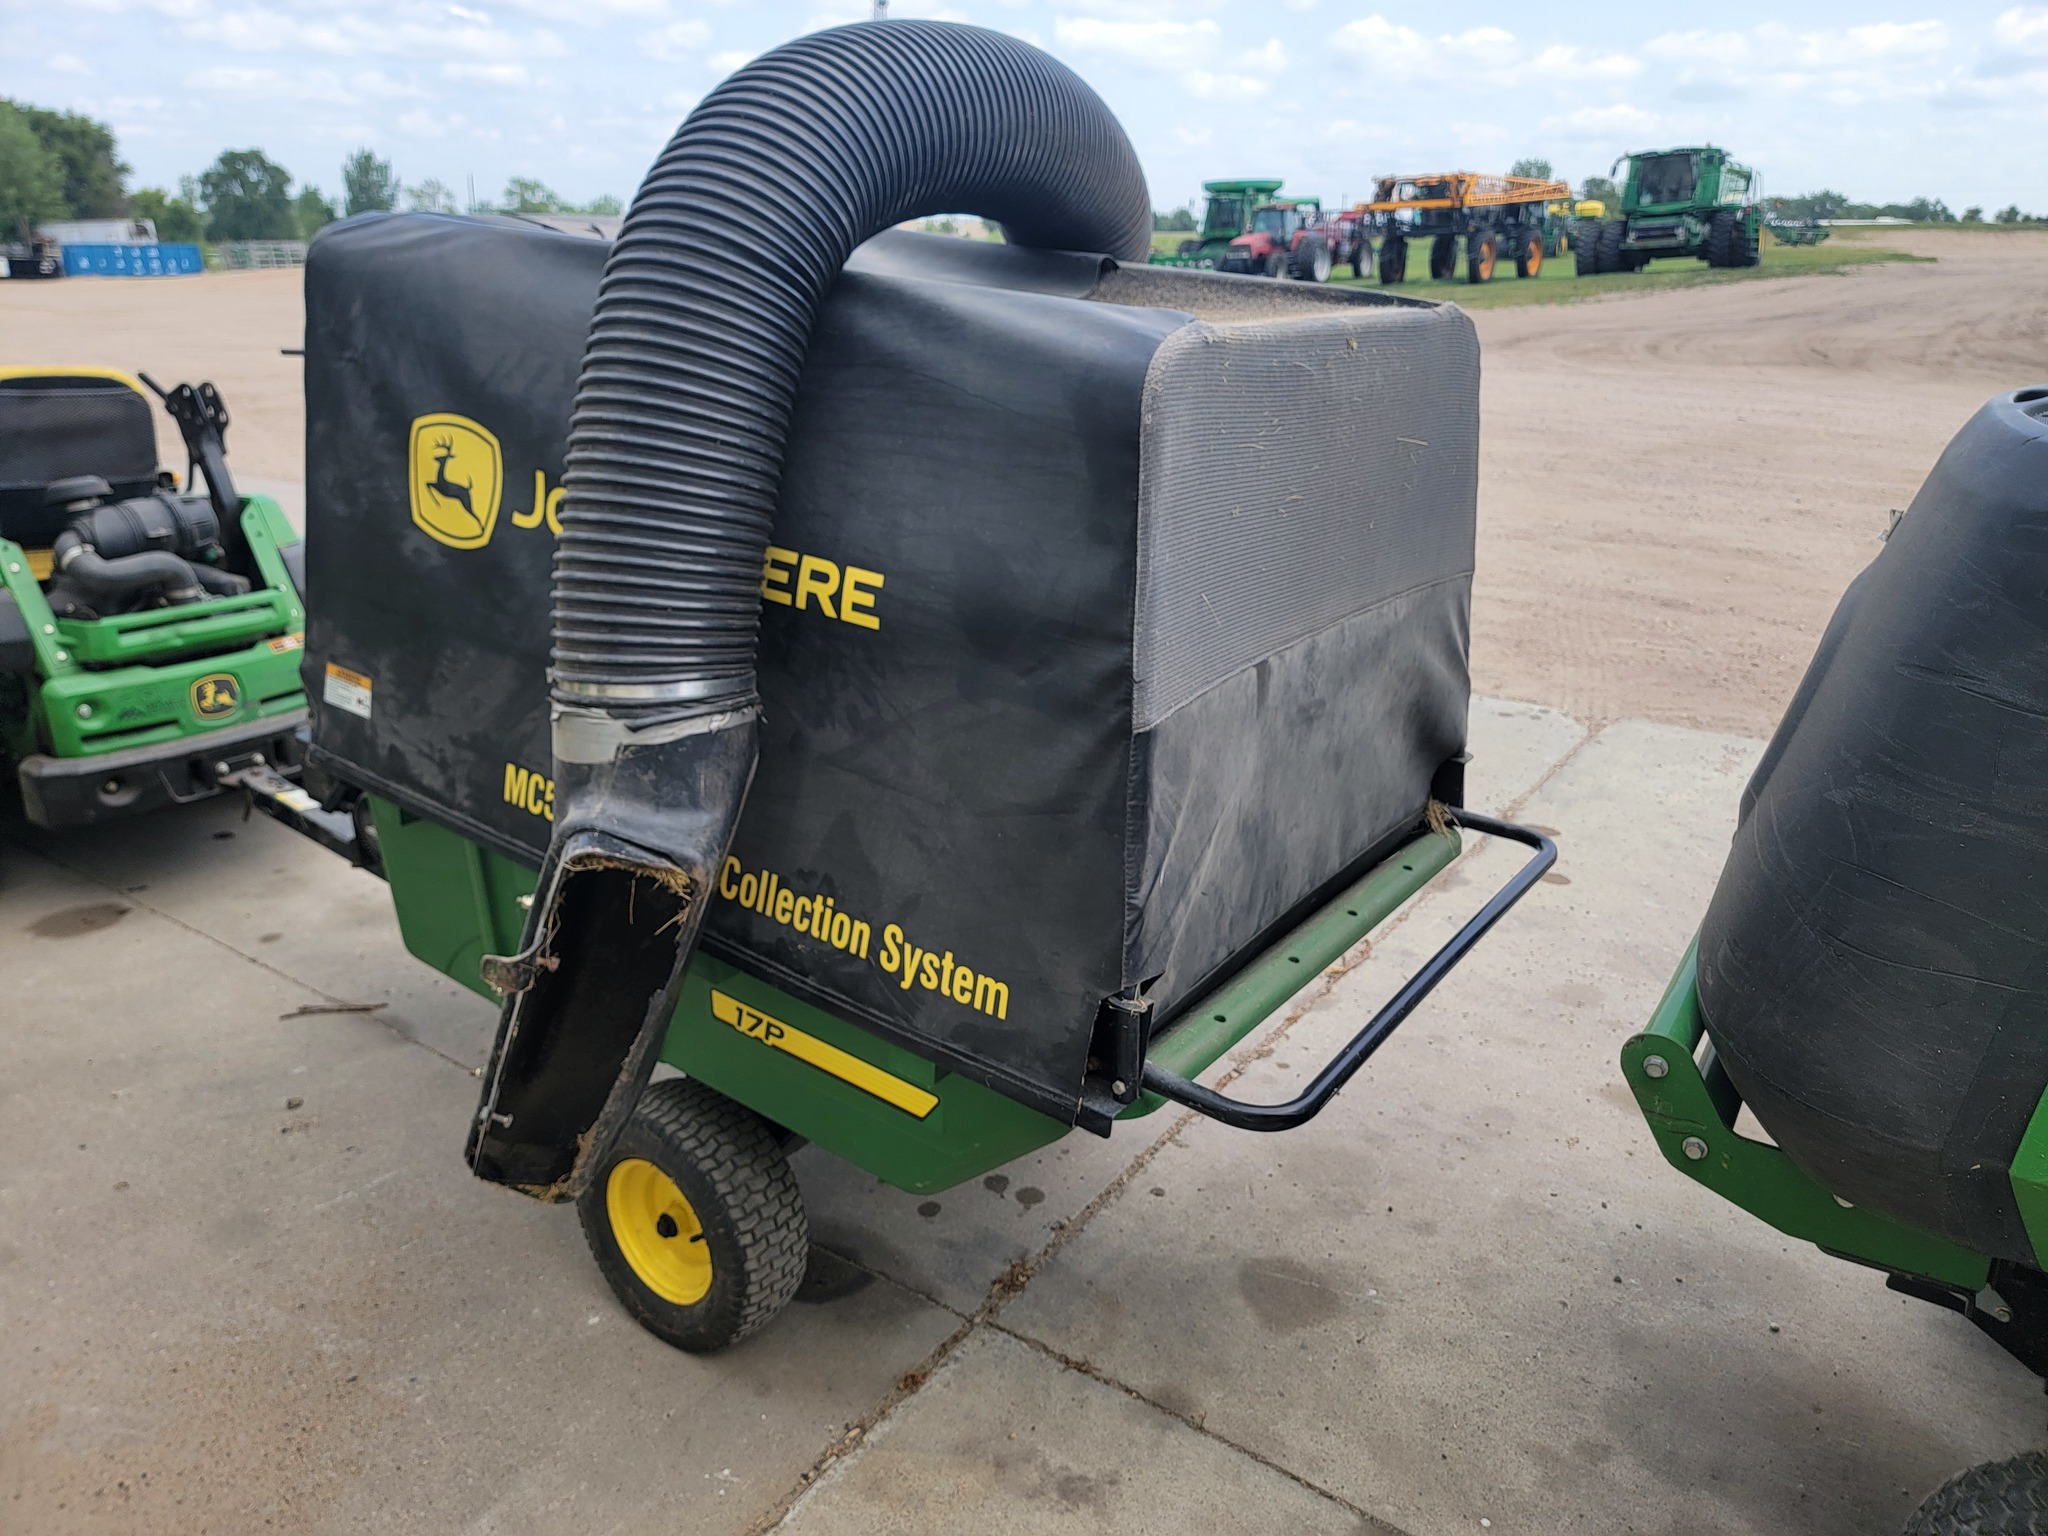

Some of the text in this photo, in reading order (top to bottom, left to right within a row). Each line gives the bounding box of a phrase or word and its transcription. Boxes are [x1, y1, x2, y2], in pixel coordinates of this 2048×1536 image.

[761, 545, 885, 631] ERE
[719, 854, 871, 959] Collection
[879, 922, 1009, 1020] System
[736, 1006, 784, 1040] 17P
